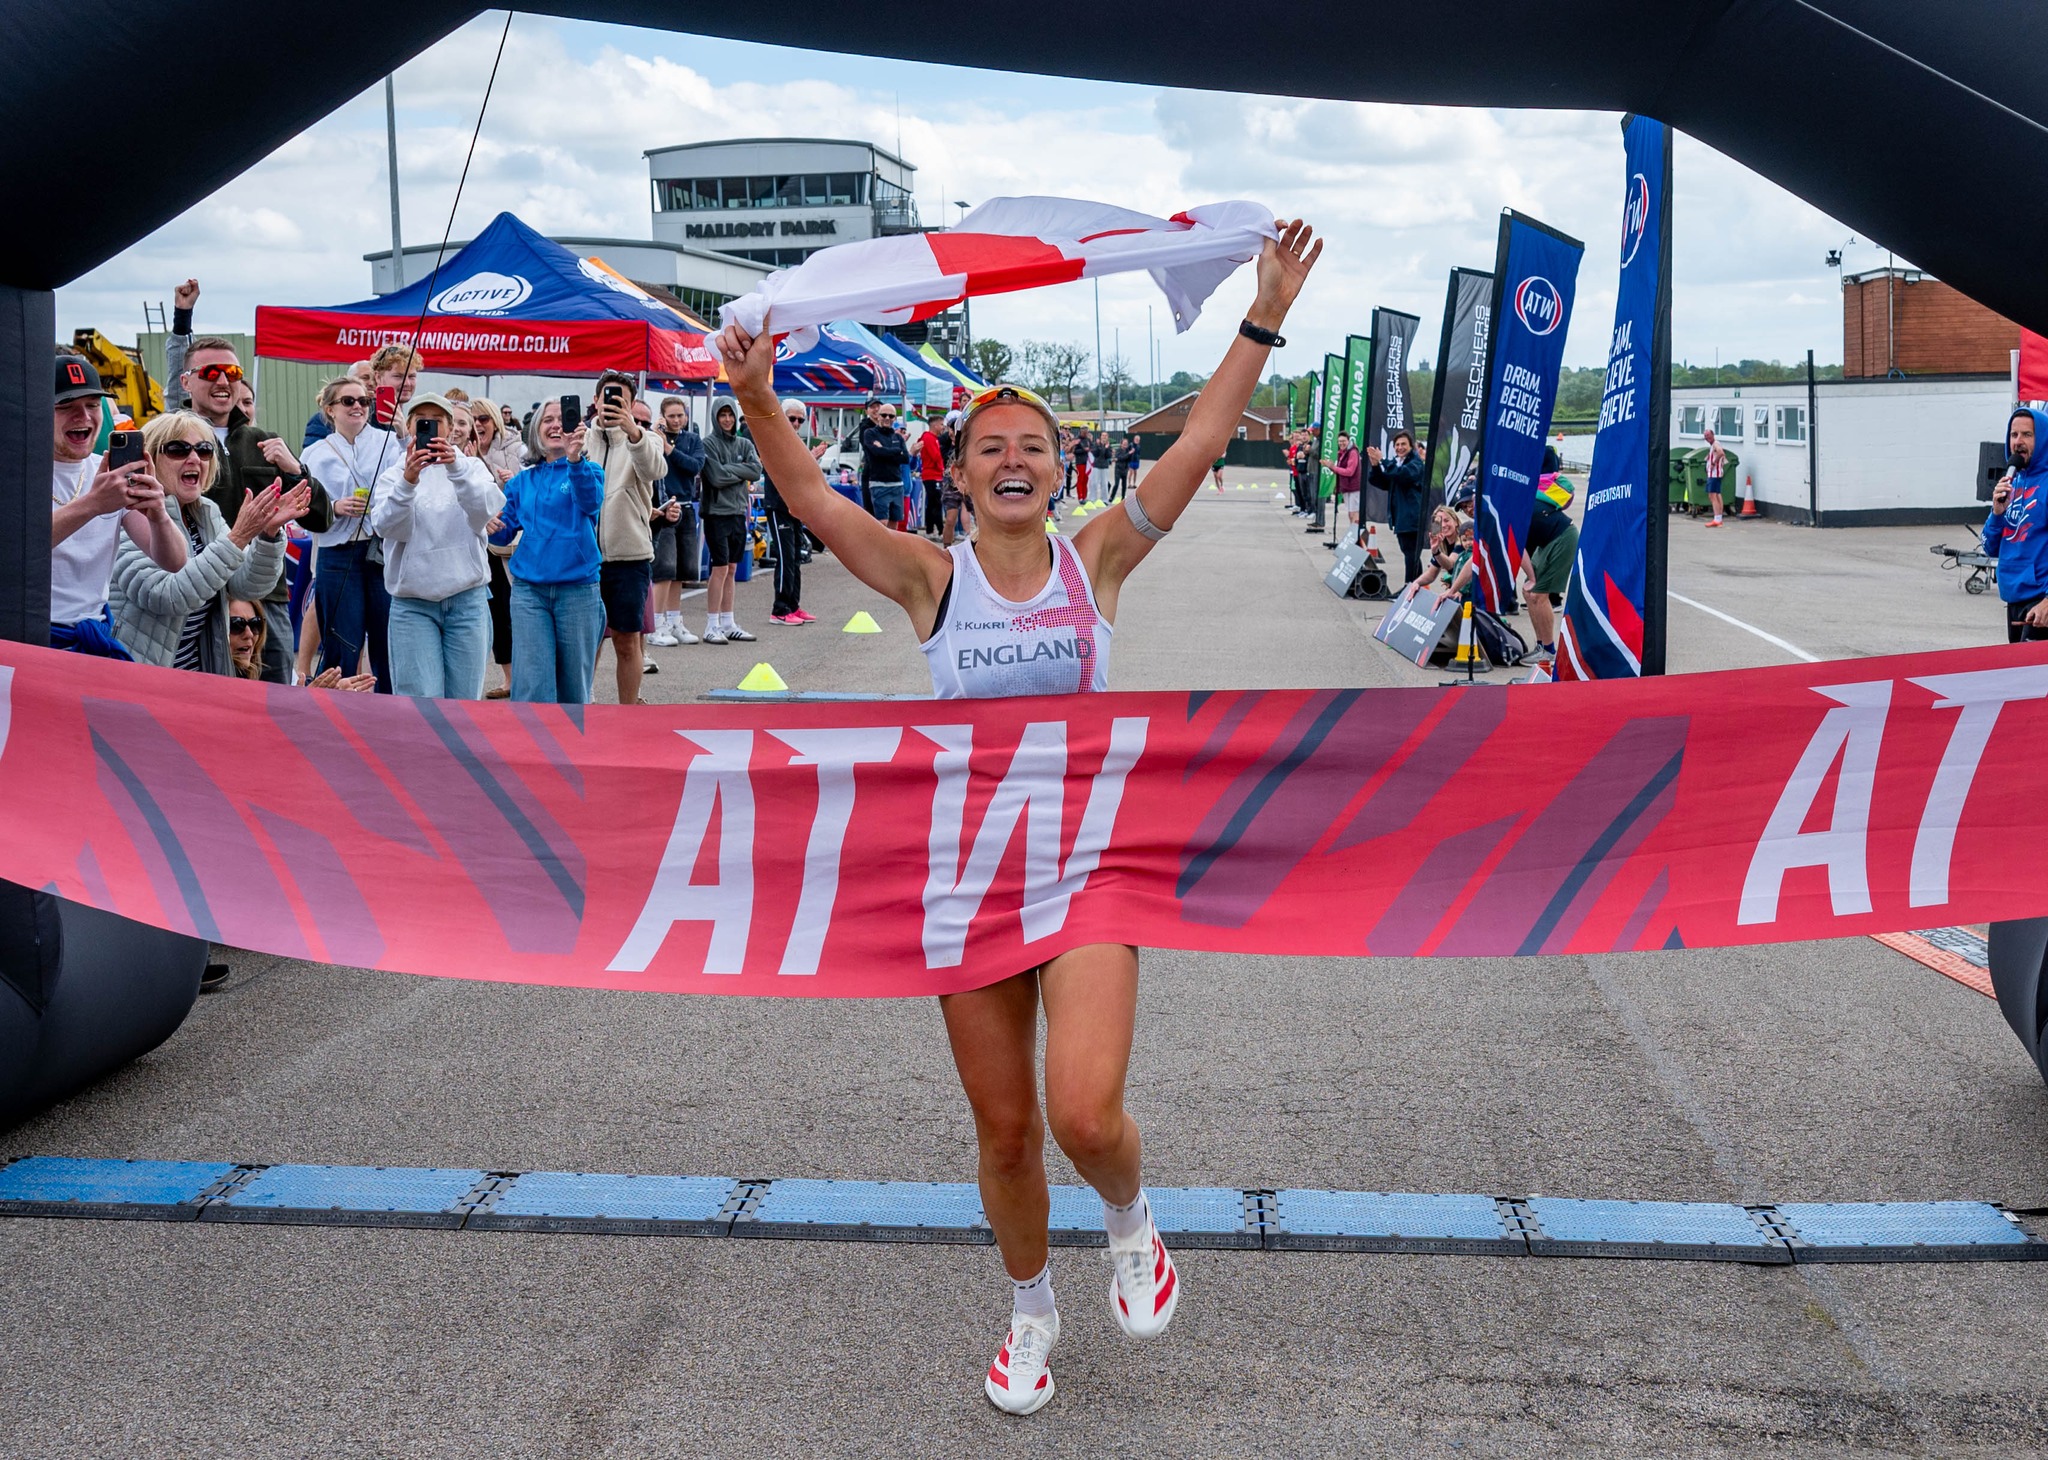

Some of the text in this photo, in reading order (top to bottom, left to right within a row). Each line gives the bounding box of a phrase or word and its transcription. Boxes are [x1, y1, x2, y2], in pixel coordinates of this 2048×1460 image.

[685, 219, 836, 239] MALLORY PARK
[446, 288, 515, 305] ACTIVE
[1525, 290, 1555, 320] ATW
[337, 328, 570, 353] ACTIVETRAININGWORLD.CO.UK
[1387, 335, 1399, 429] SKECHERS
[1461, 305, 1486, 429] SKECHERS
[1503, 364, 1541, 394] DREAM.
[1396, 337, 1404, 430] PERFORMANCE
[1500, 385, 1541, 417] BELIEVE.
[1322, 375, 1342, 476] reviveactie
[1497, 408, 1540, 440] ACHIEVE.
[965, 621, 1005, 630] KUKRI
[958, 638, 1092, 670] ENGLAND
[605, 716, 1150, 976] ATW
